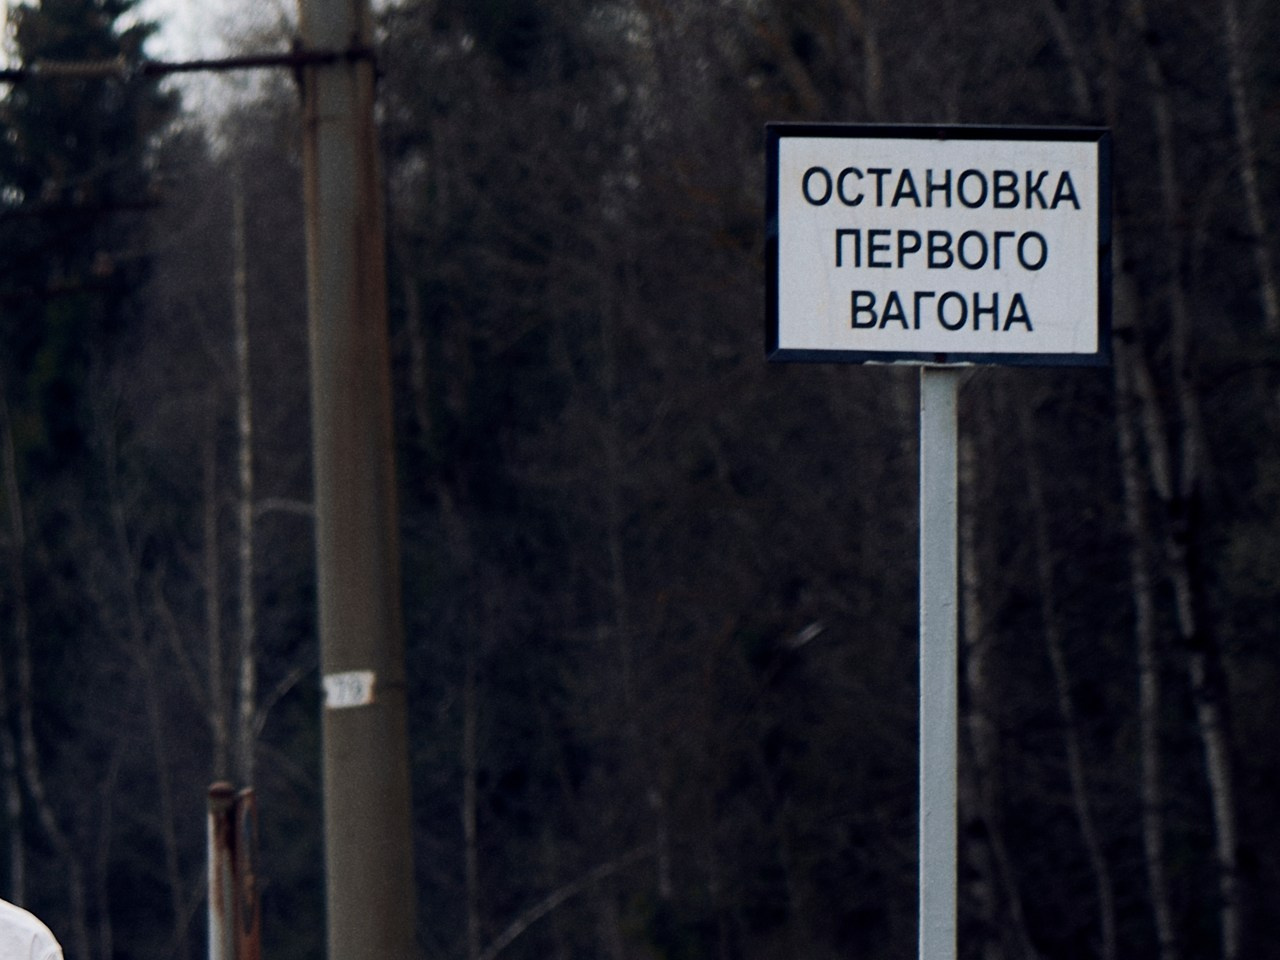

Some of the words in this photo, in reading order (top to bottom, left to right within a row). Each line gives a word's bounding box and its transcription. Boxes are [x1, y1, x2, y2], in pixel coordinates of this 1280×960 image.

[801, 165, 1082, 211] ОСТАНОВКА
[835, 228, 1049, 272] ПЕРВОГО
[850, 289, 1034, 332] ВАГОНА
